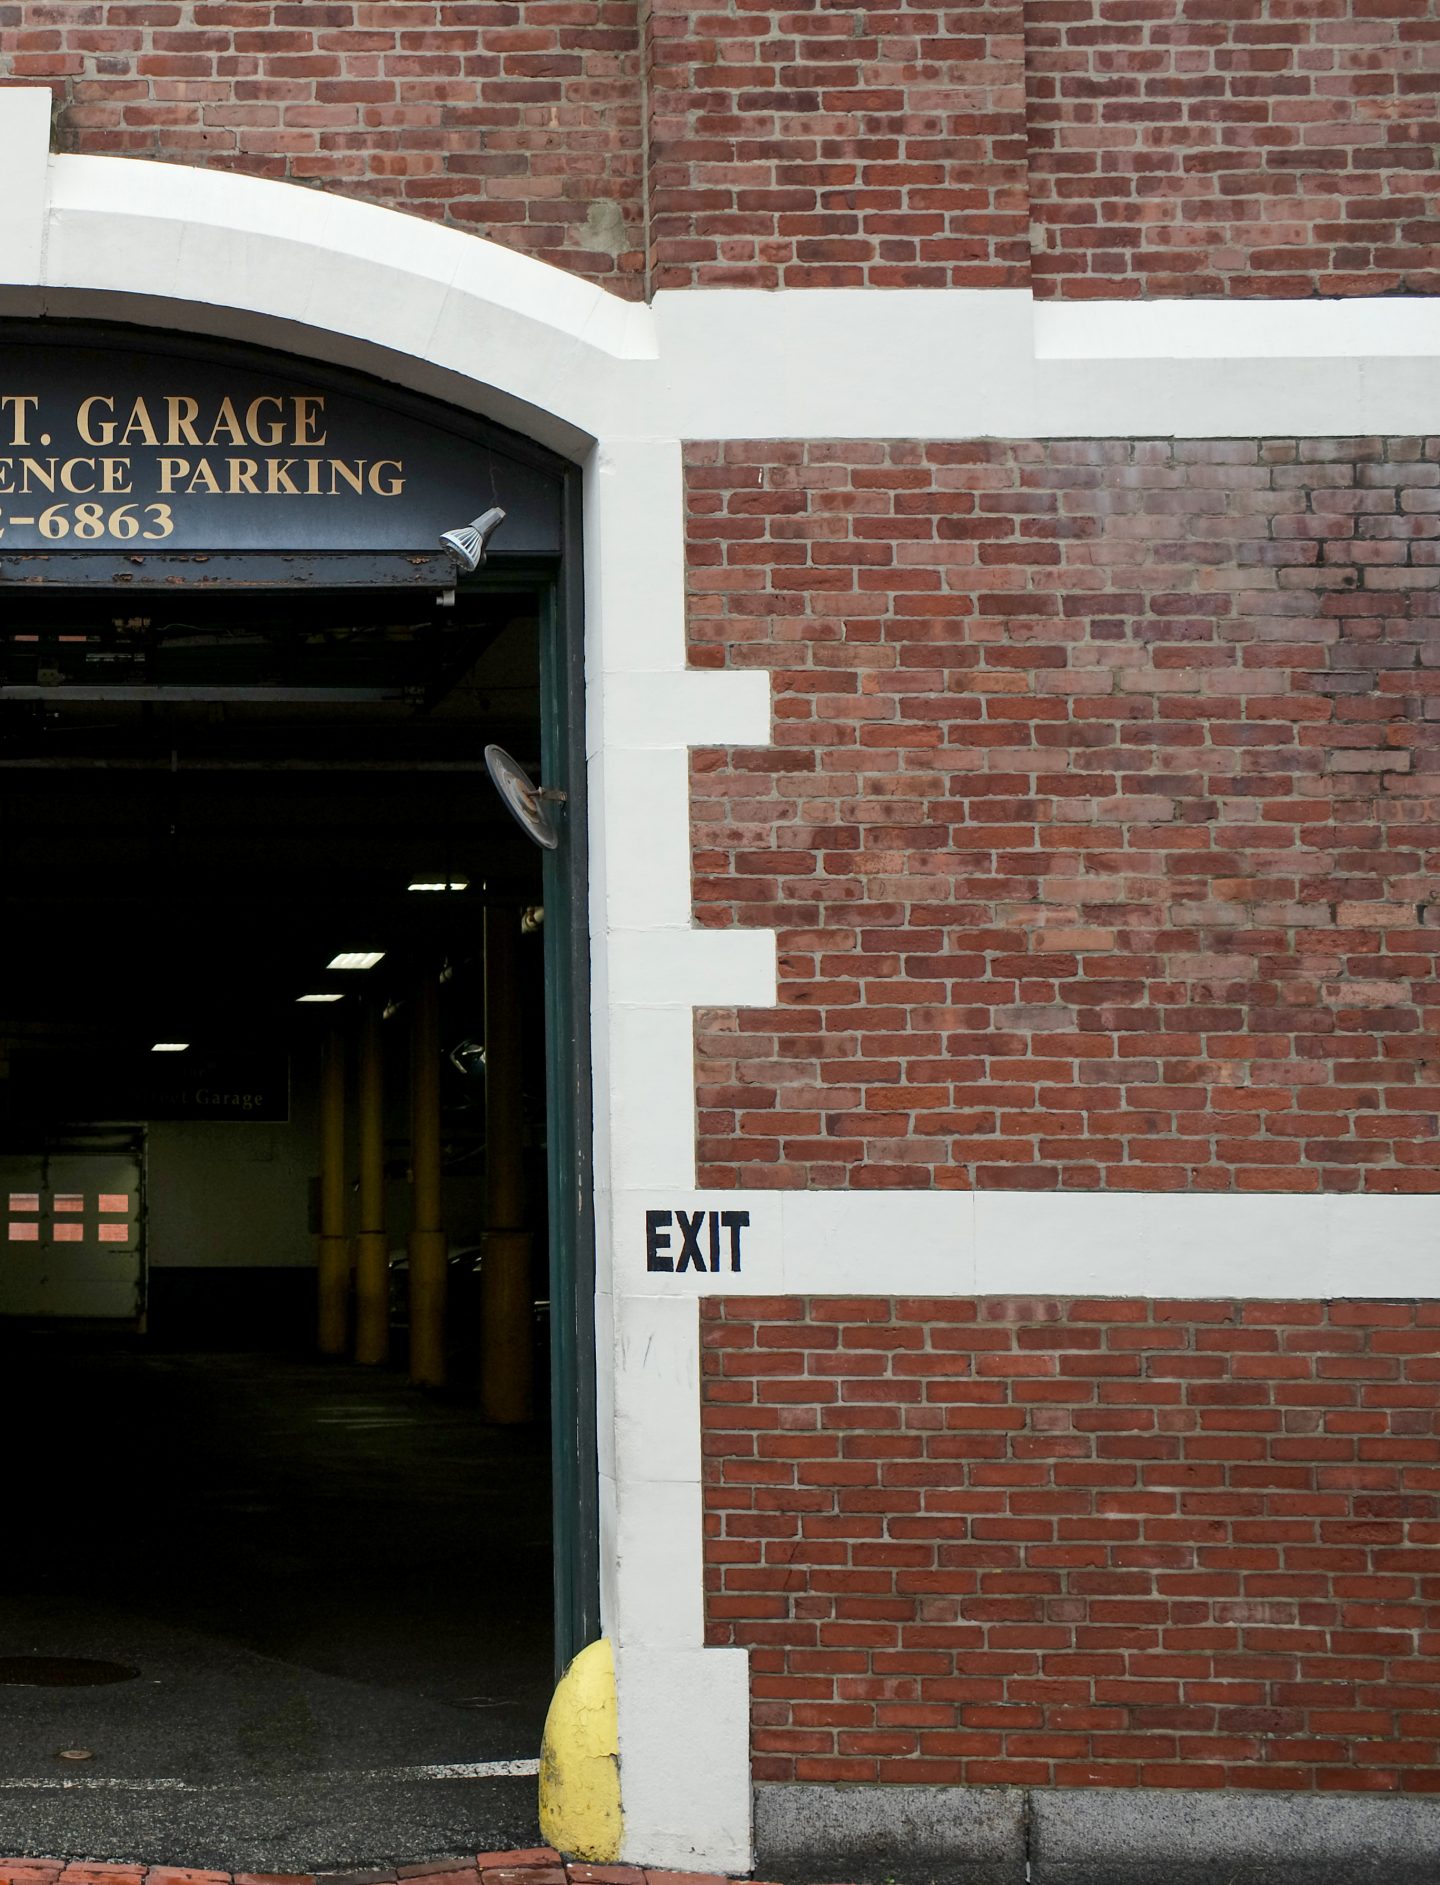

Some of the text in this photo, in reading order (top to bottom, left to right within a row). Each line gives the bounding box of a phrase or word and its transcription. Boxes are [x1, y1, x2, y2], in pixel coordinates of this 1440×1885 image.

[76, 395, 327, 447] GARAGE
[158, 457, 406, 497] PARKING
[195, 1088, 264, 1111] Garage
[645, 1210, 751, 1273] EXIT
